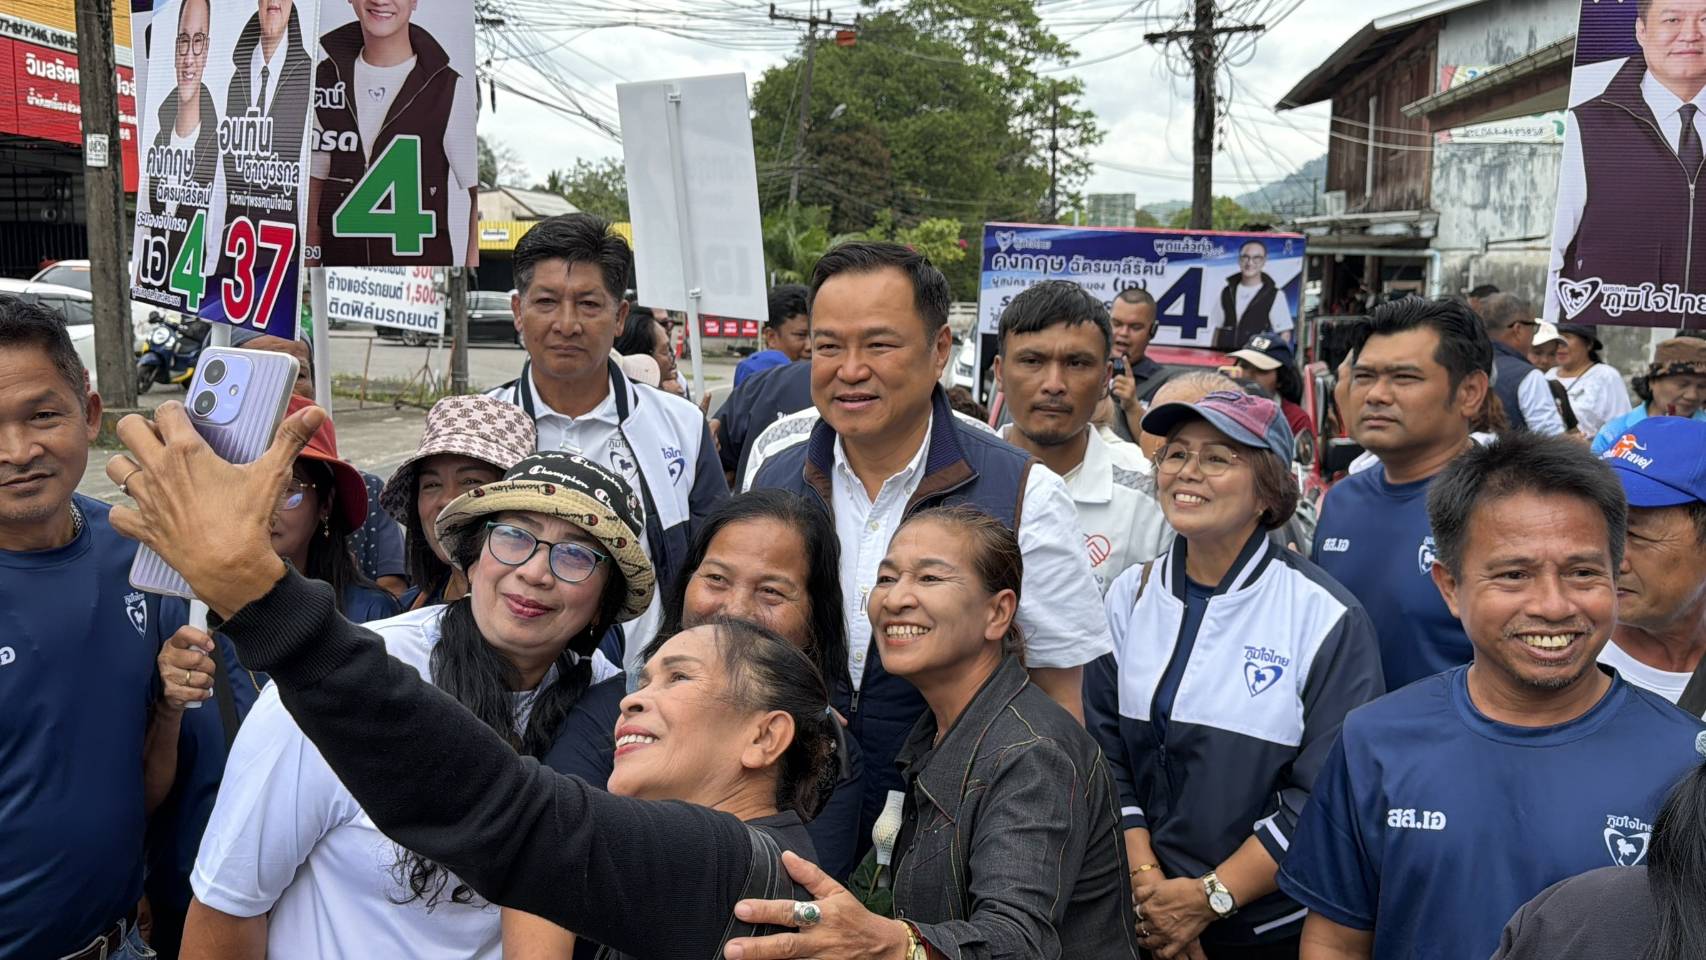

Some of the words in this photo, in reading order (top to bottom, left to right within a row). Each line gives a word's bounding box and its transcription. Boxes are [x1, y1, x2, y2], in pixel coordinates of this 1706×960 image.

[218, 107, 274, 172] อนุทิน
[145, 145, 196, 179] คงกฤษ
[243, 152, 301, 196] ชาญวีรกูล
[156, 179, 213, 207] ฉัตรมาลีรัตน์
[332, 134, 437, 257] 4
[140, 234, 169, 287] เอ
[169, 208, 208, 313] 4
[221, 215, 297, 330] 37
[993, 253, 1065, 275] คงกฤษ
[1069, 255, 1168, 276] ฉัตรมาลีรัตน์
[327, 271, 404, 300] ล้างแอร์รถยนต์
[328, 297, 440, 330] ติดฟิล์มรถยนต์
[1156, 266, 1209, 340] 4
[528, 465, 590, 489] Champion
[1244, 645, 1290, 667] ภูมิใจไทย
[1387, 808, 1447, 831] สส.เอ
